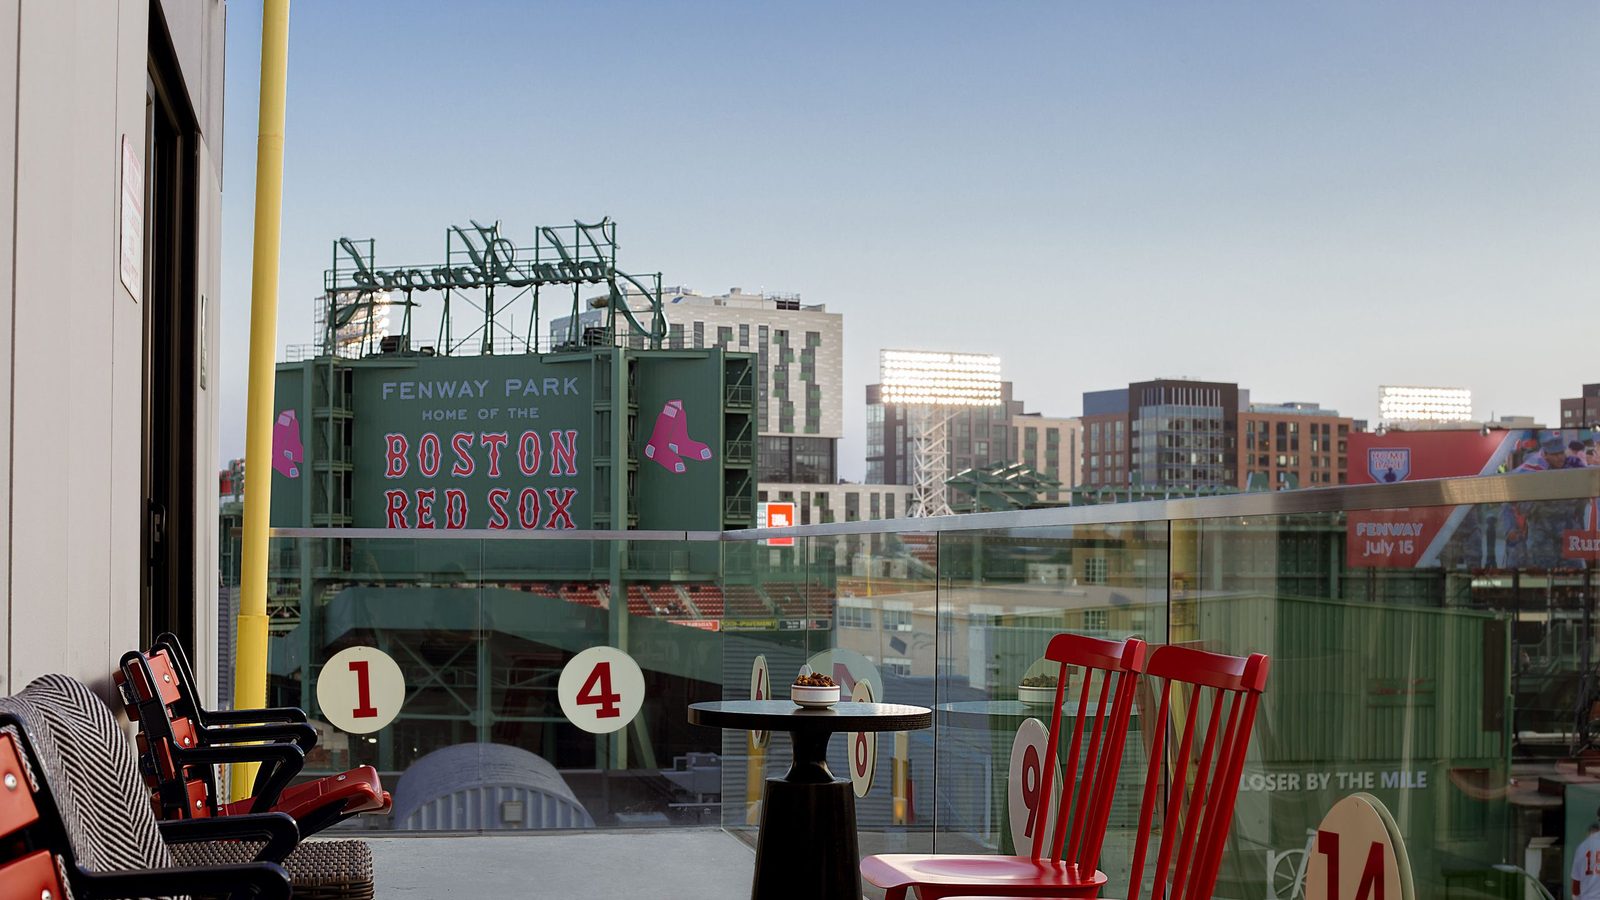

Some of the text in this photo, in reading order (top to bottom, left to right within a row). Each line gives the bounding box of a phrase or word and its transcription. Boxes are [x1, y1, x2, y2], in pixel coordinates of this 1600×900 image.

[382, 377, 579, 401] FENWAY PARK
[422, 407, 540, 421] HOME OF THE
[384, 429, 579, 479] BOSTON
[384, 487, 579, 530] RED SOX
[1356, 522, 1424, 537] FENWAY
[1362, 539, 1395, 557] July
[348, 660, 378, 719] 1
[575, 661, 621, 719] 4
[1021, 744, 1041, 839] 9
[1239, 770, 1427, 792] LOSER BY THE MILE
